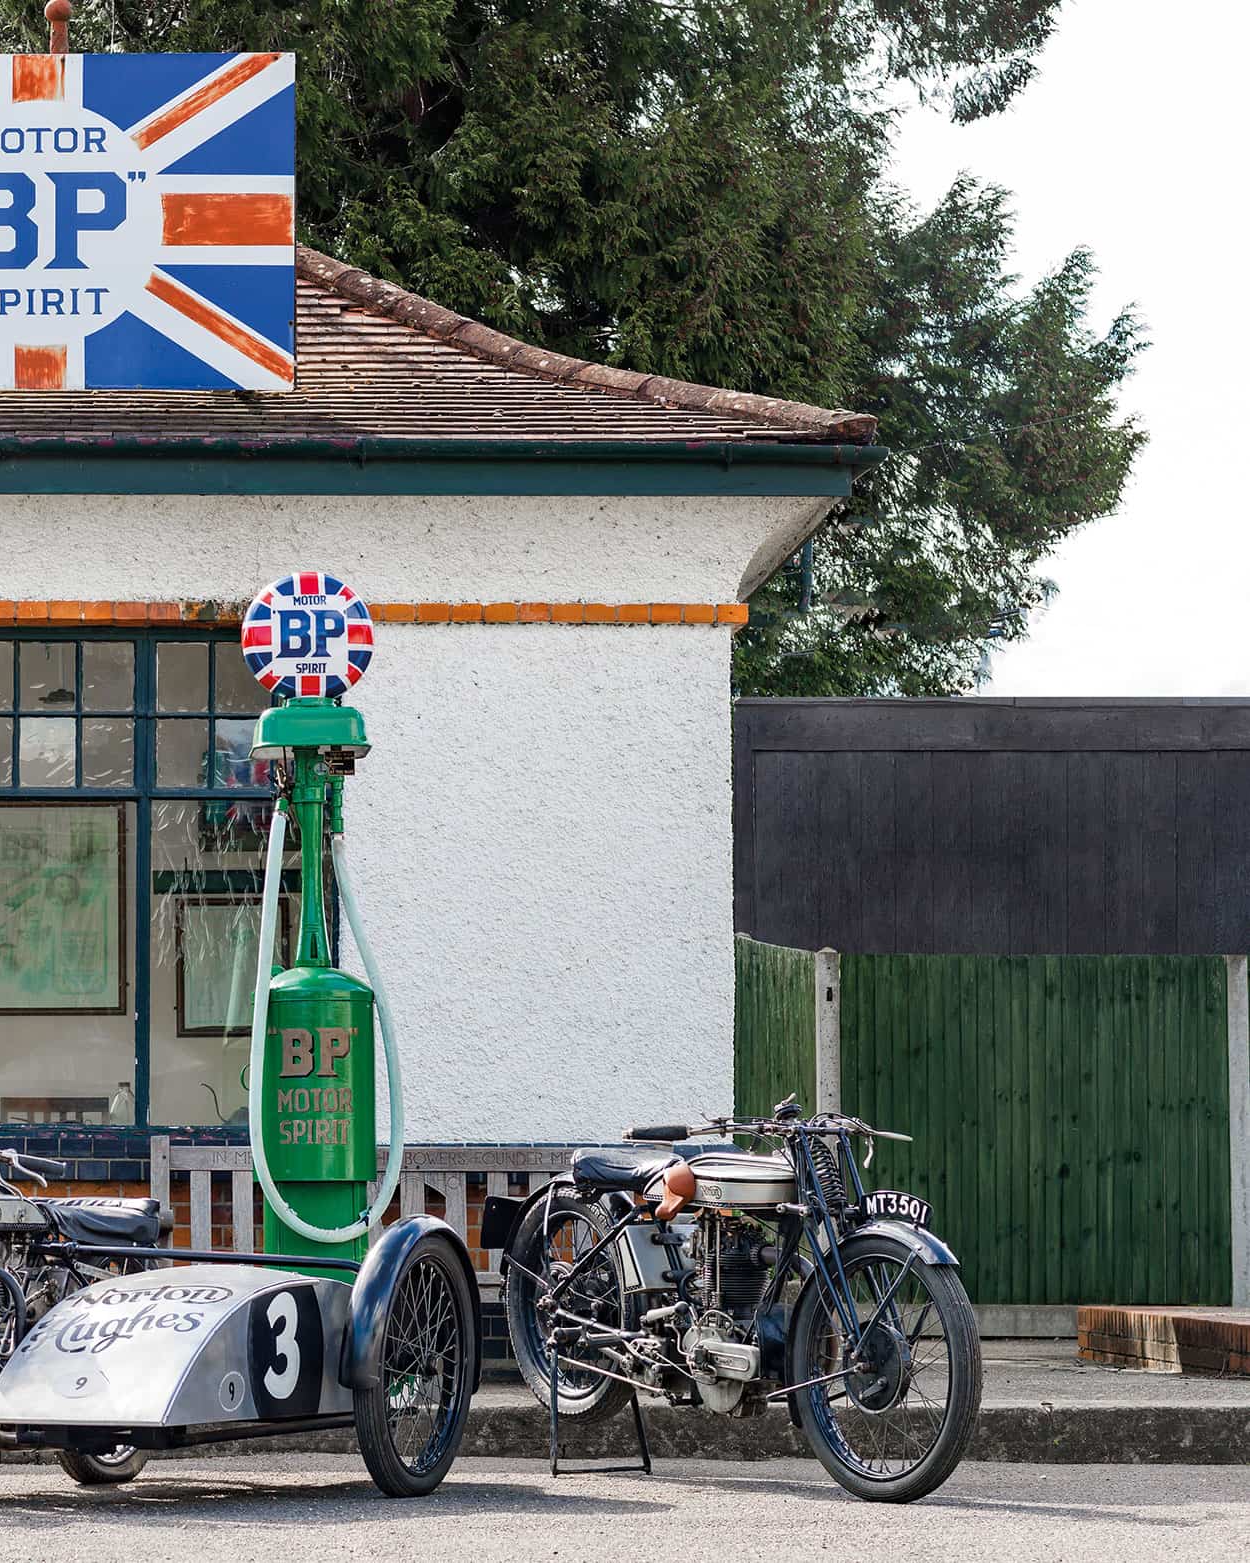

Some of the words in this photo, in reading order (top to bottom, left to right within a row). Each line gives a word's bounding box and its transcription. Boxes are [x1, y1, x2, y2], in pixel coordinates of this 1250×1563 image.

[293, 595, 327, 606] MOTOR
[295, 662, 327, 674] SPIRIT
[277, 1087, 353, 1113] MOTOR
[279, 1119, 351, 1145] SPIRIT
[471, 1151, 543, 1166] FOUNDER
[866, 1193, 928, 1224] MT3501
[65, 1285, 234, 1308] Norton
[22, 1303, 204, 1353] Hughes
[263, 1291, 300, 1400] 3
[75, 1376, 88, 1391] 9
[228, 1381, 236, 1402] 9
